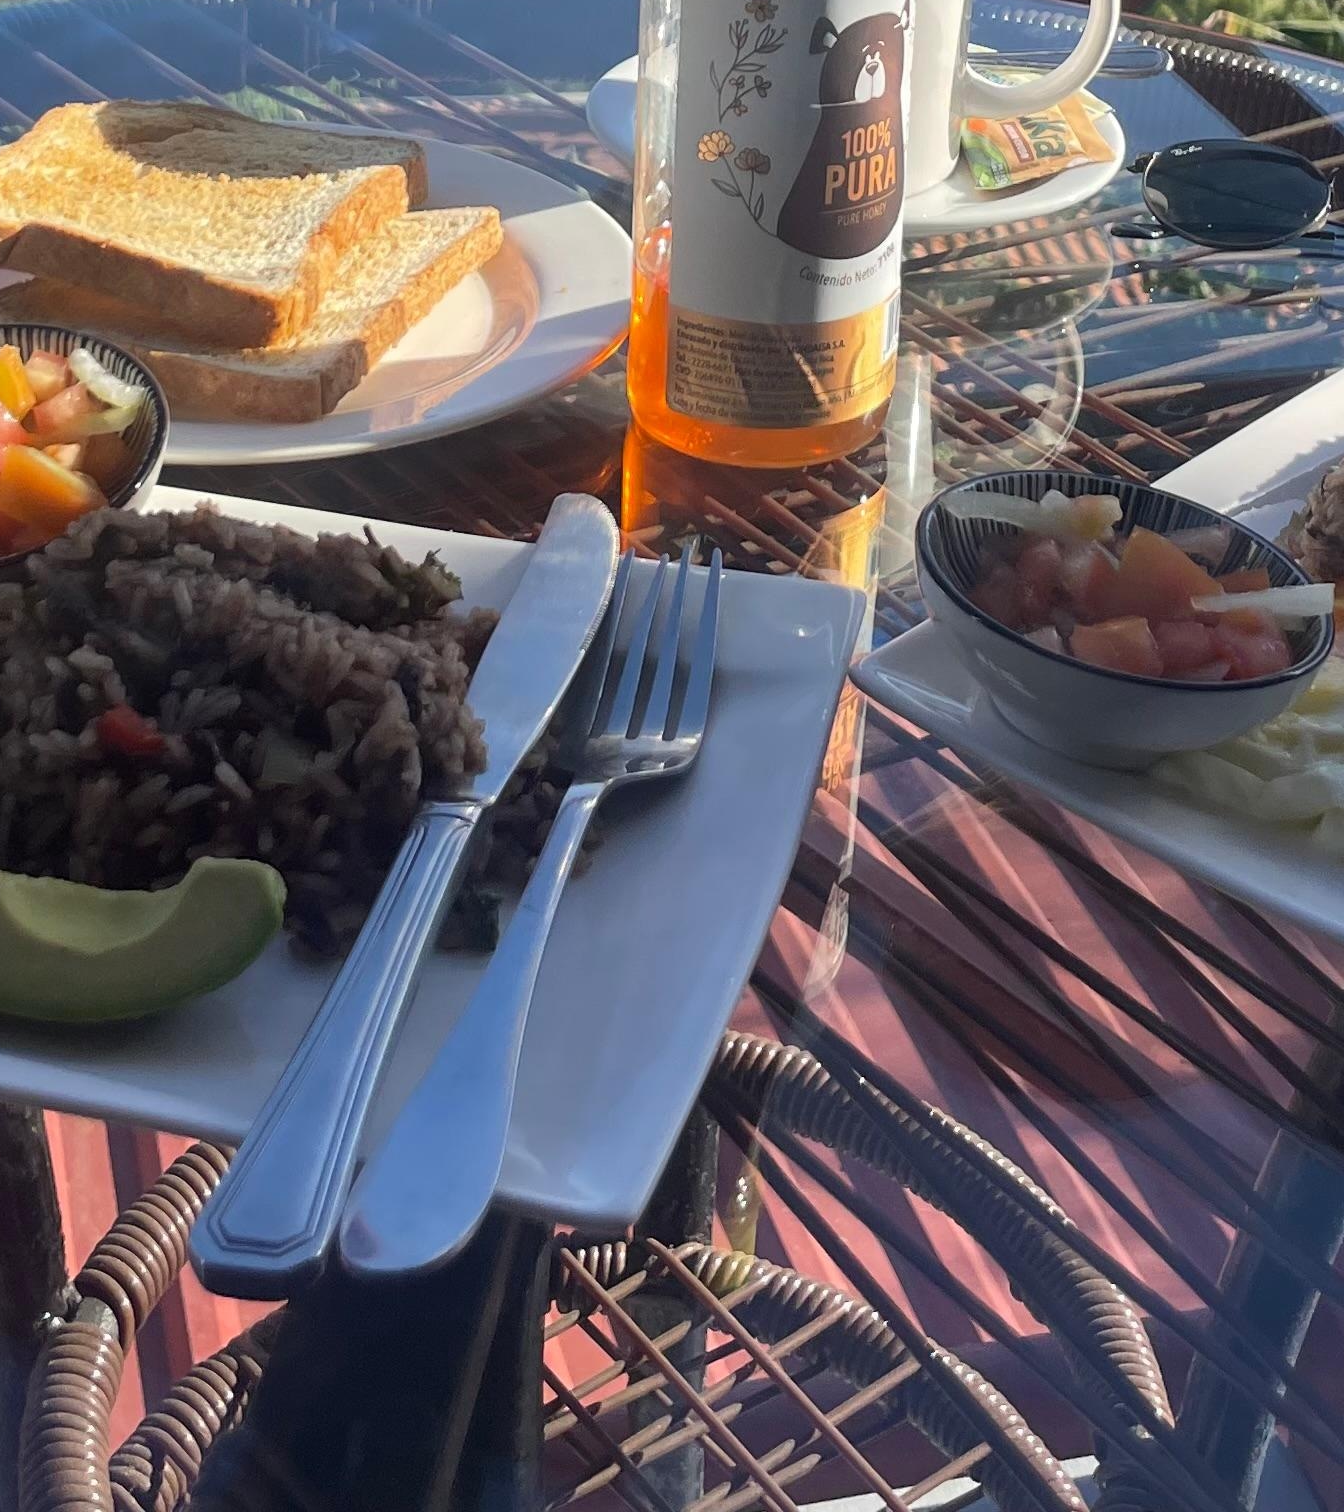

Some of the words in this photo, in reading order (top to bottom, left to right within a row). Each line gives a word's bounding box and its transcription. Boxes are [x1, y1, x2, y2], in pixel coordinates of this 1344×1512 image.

[841, 117, 892, 160] 100%
[824, 146, 896, 206] PURA
[837, 209, 861, 226] PURE
[862, 201, 887, 222] HONEY
[799, 265, 853, 287] Contenido
